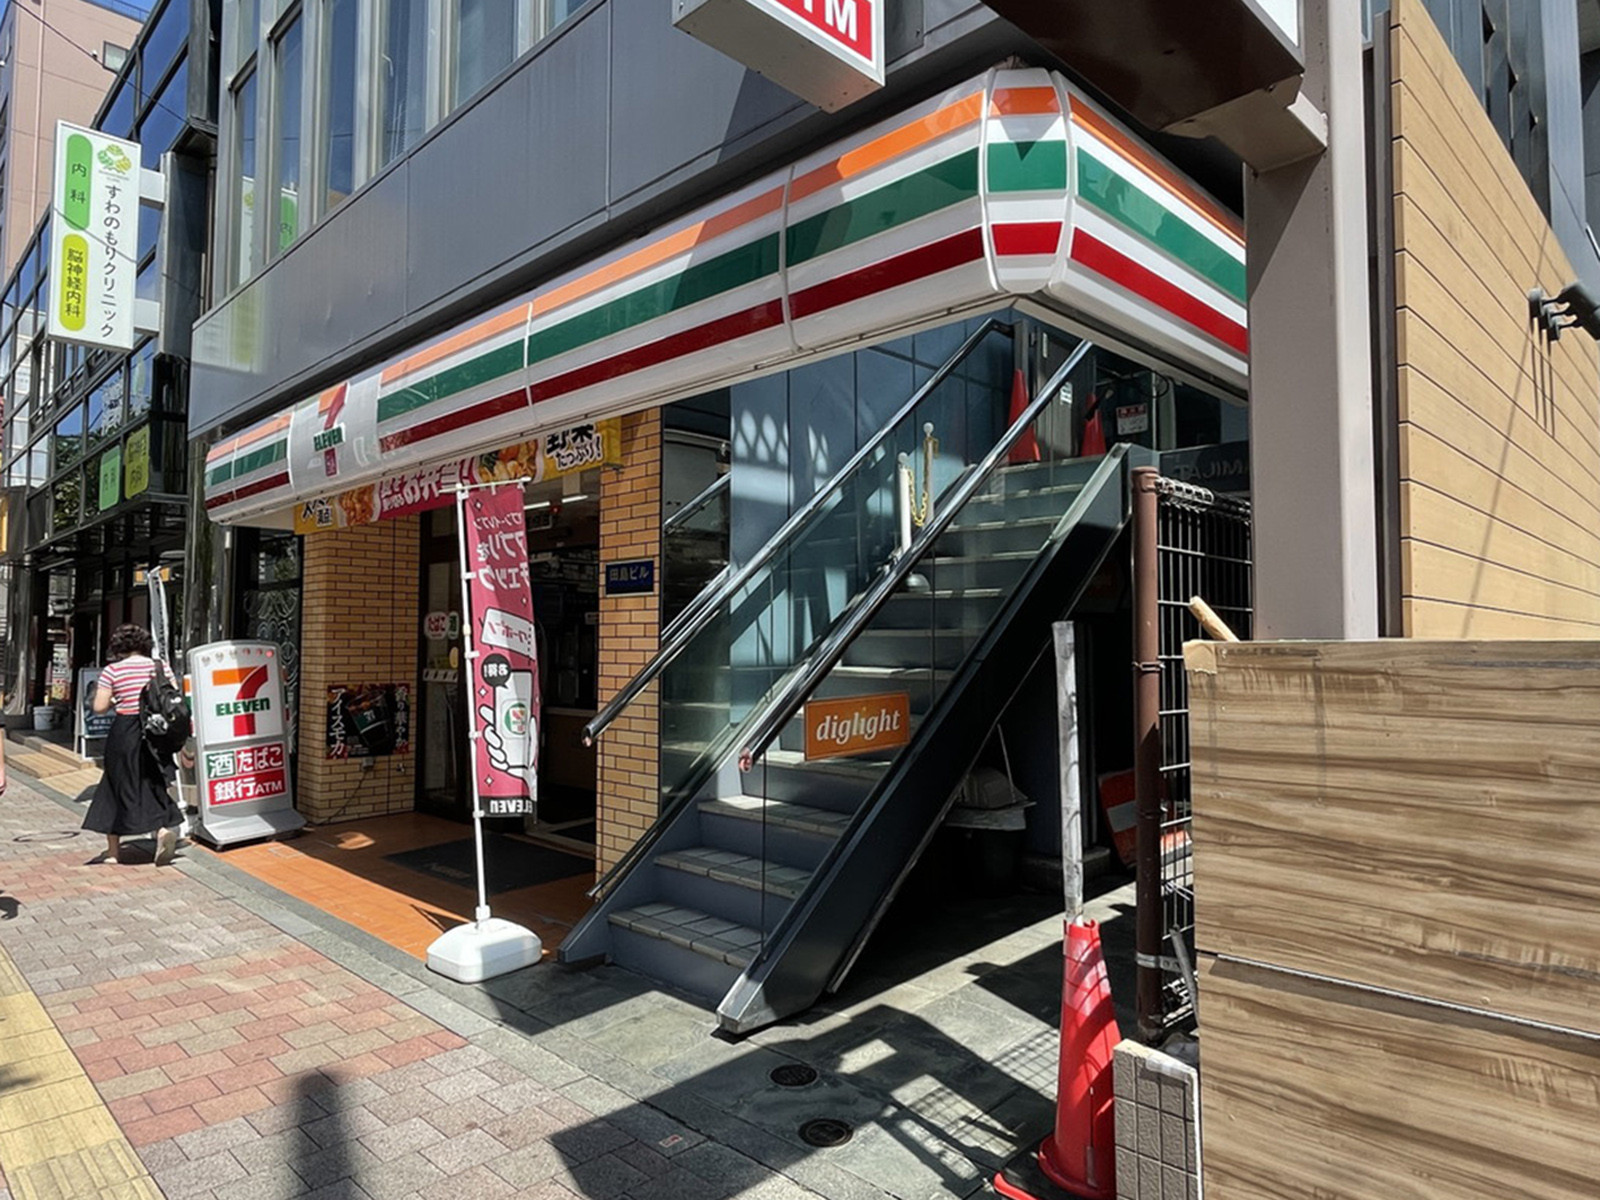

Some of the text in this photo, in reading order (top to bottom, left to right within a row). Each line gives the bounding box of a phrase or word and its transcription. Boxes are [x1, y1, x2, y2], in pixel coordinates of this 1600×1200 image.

[71, 162, 87, 204] 内科
[66, 247, 84, 318] 脳神経内科
[100, 184, 123, 338] すわのもりクリニック
[1174, 458, 1248, 480] TAJIM
[212, 664, 269, 737] 7
[329, 688, 346, 756] アイスモカ
[816, 707, 901, 745] diglight
[208, 746, 283, 778] 酒 たばこ
